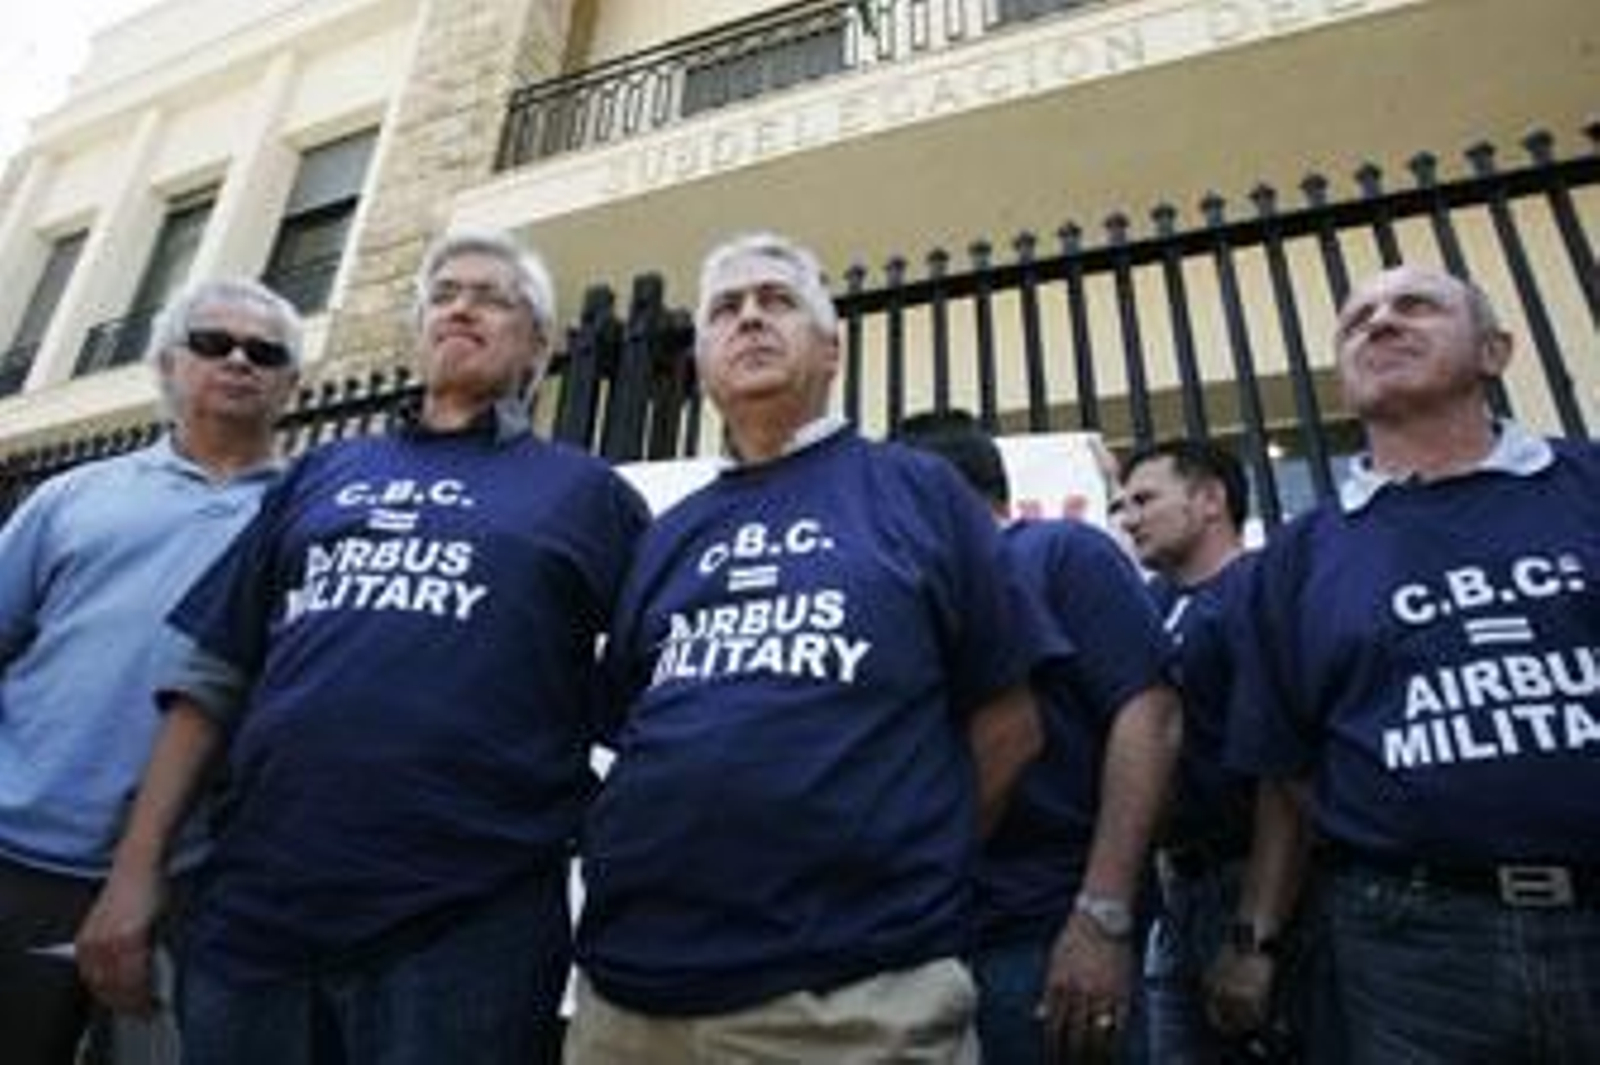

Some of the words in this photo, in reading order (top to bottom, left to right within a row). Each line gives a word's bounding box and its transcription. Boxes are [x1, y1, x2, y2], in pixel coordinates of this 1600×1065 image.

[284, 574, 487, 622] LITARY
[650, 633, 871, 687] LITARY
[1405, 647, 1600, 722] AIRBU
